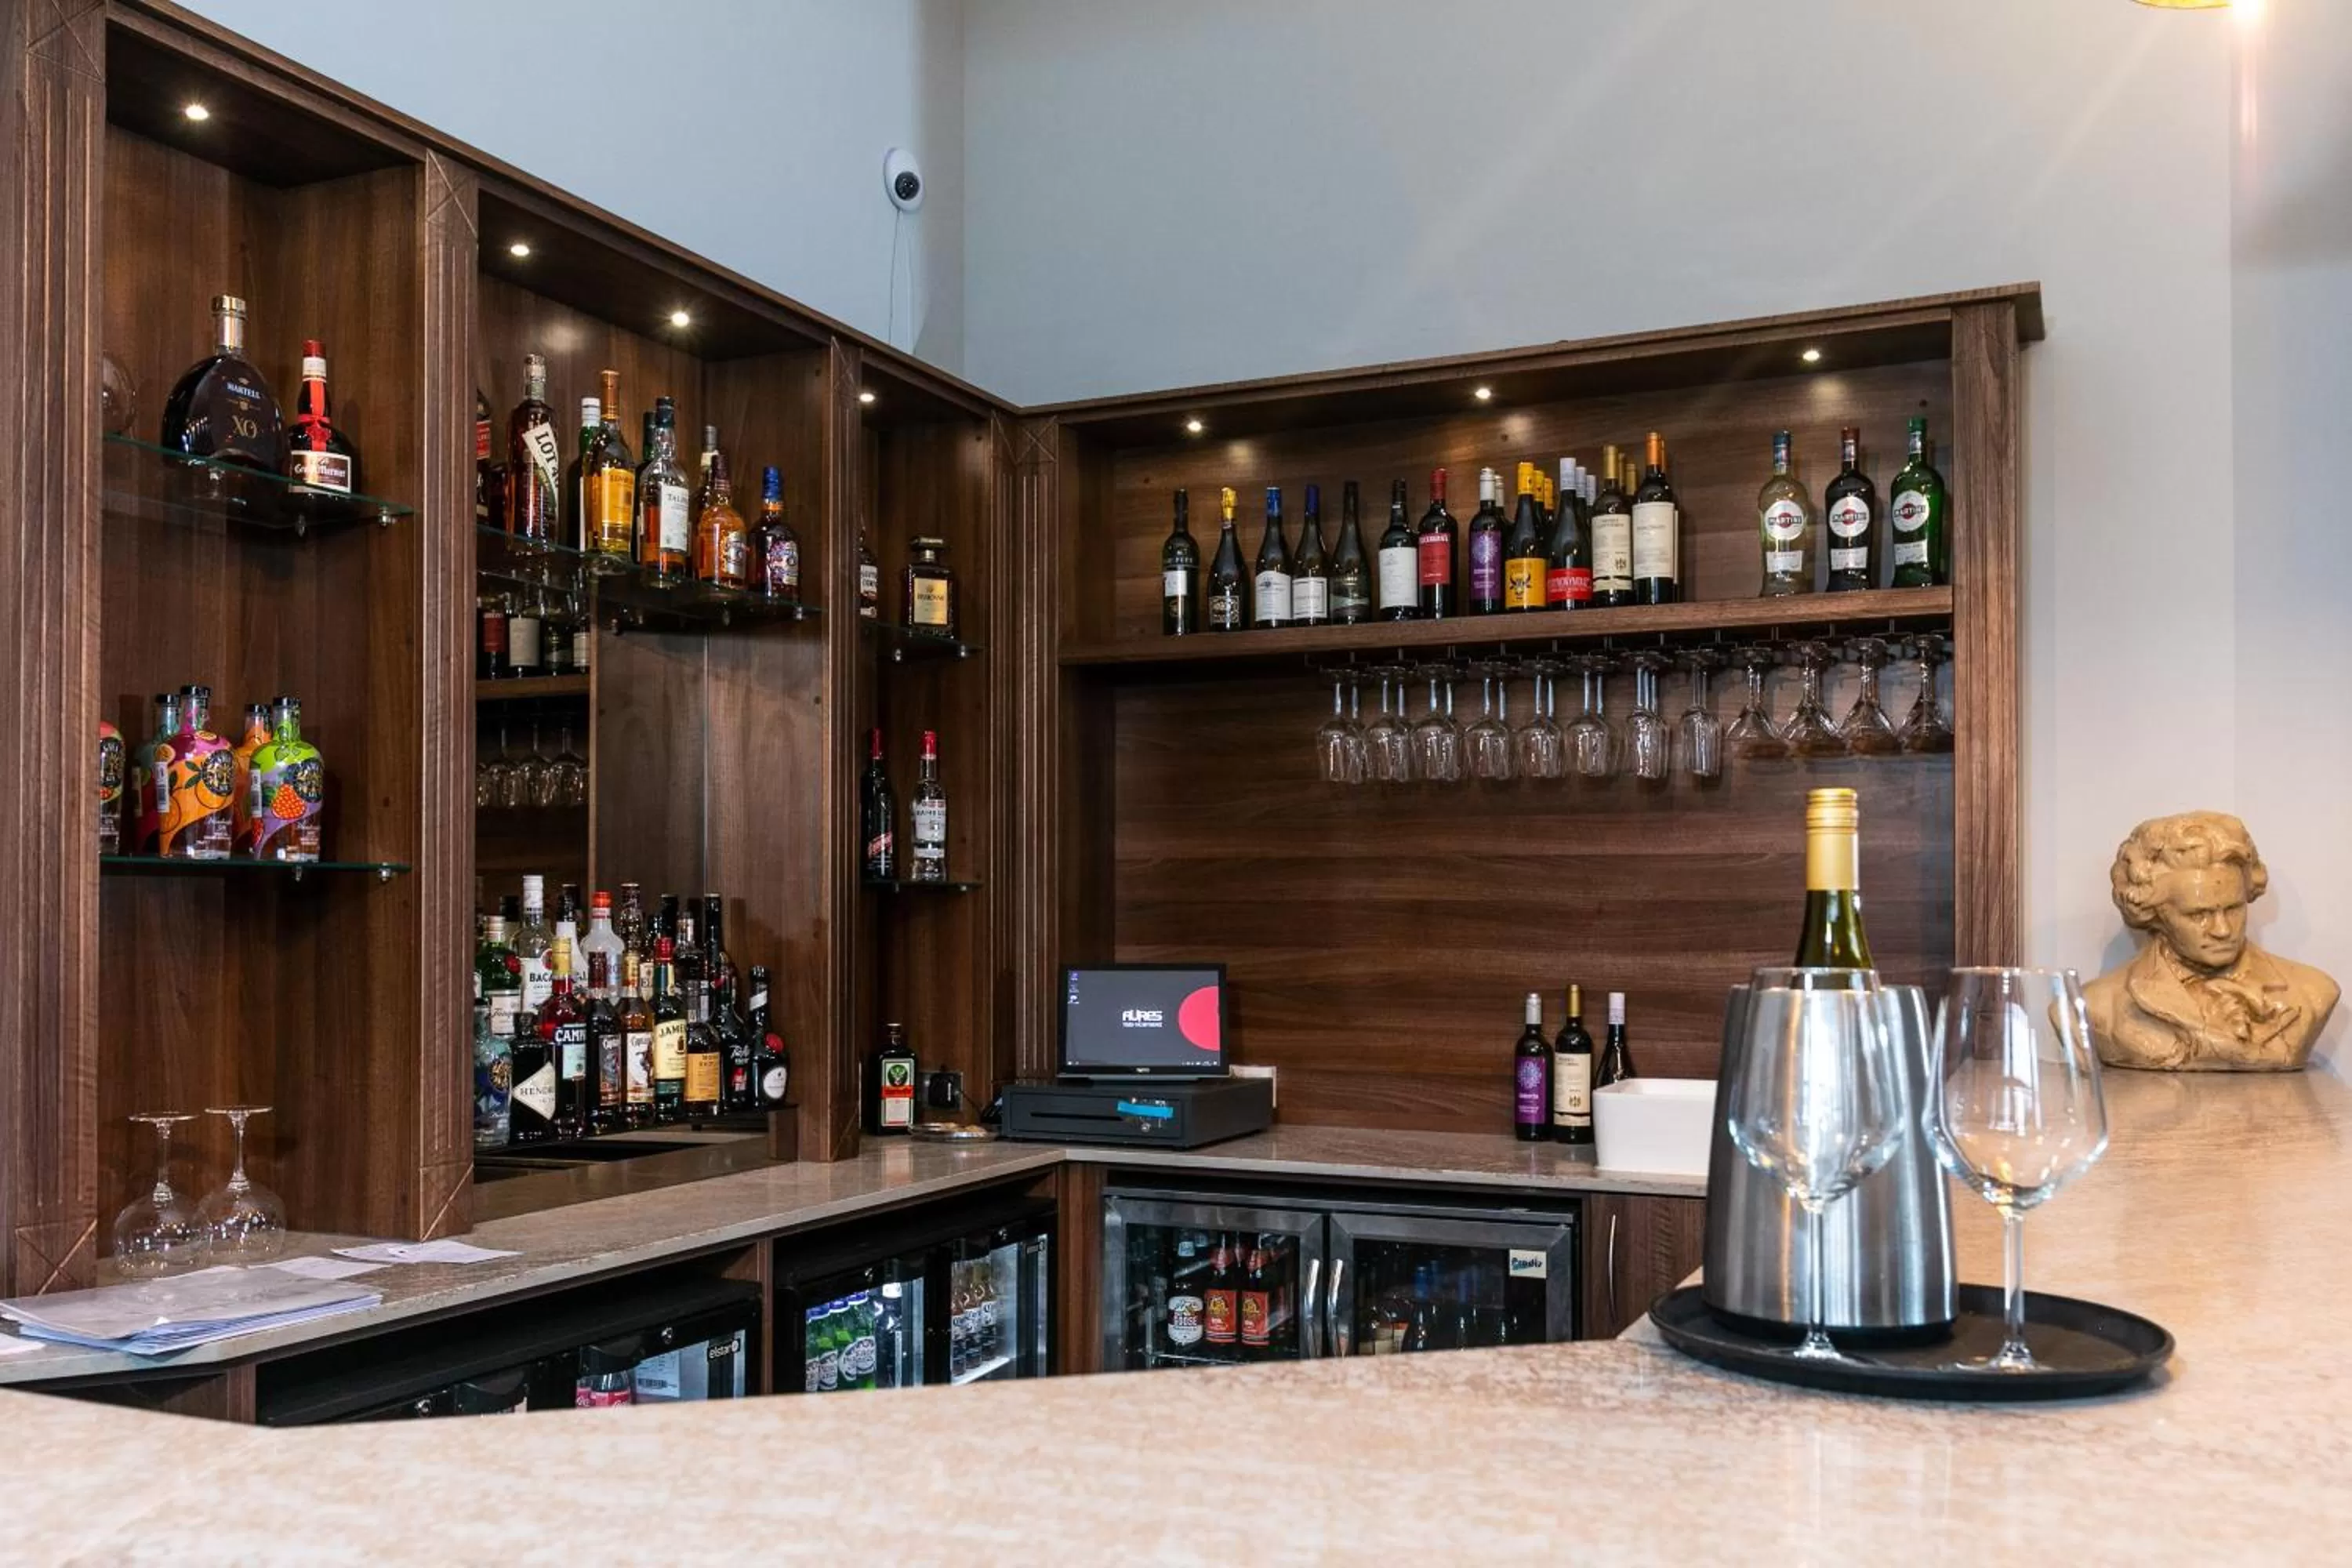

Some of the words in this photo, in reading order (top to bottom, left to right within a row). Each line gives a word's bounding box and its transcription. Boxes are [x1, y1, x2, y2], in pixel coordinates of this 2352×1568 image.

[227, 382, 261, 400] MARTELL
[232, 415, 258, 439] XO
[535, 431, 559, 463] LOT
[709, 1342, 732, 1359] elstar
